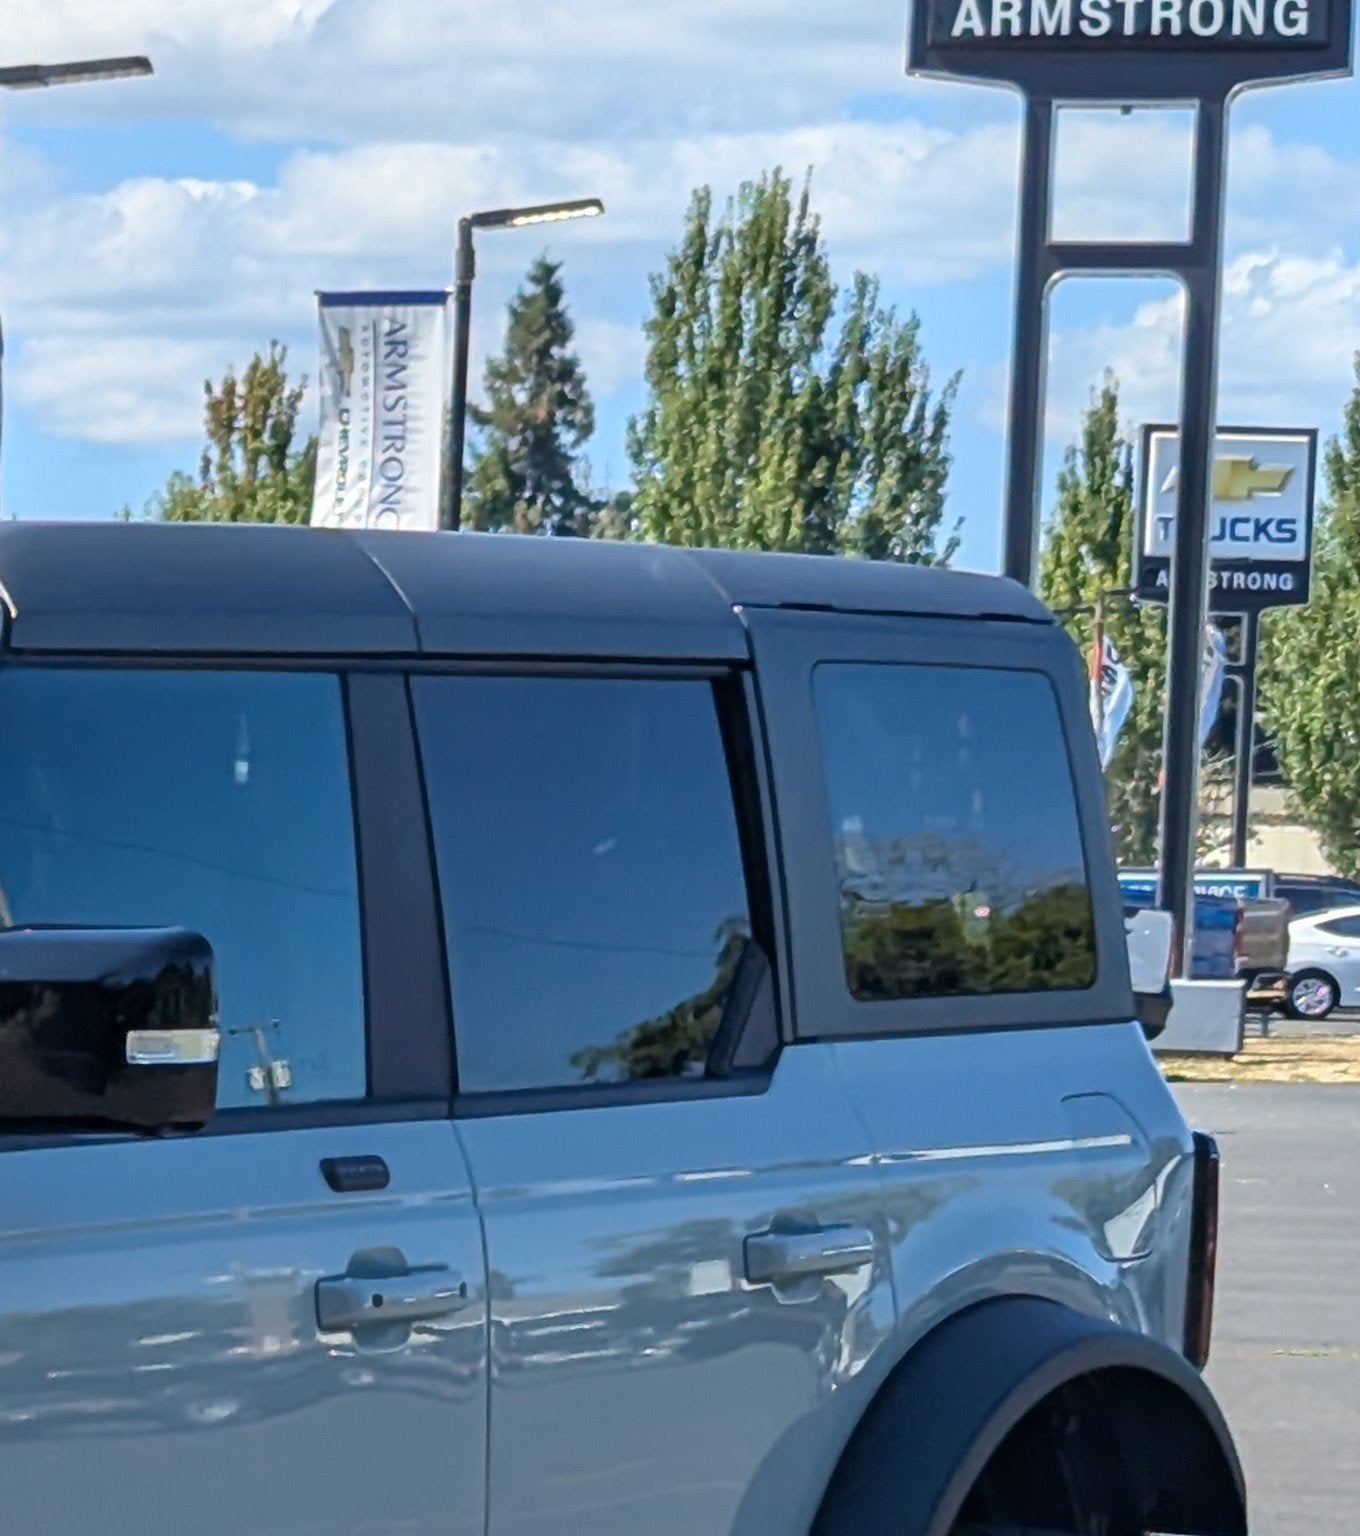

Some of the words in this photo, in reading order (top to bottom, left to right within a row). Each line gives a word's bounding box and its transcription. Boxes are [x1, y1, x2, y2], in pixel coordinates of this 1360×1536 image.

[951, 0, 1310, 38] ARMSTRONG
[1156, 515, 1298, 543] TUCKS
[1155, 568, 1295, 591] ASTRONG
